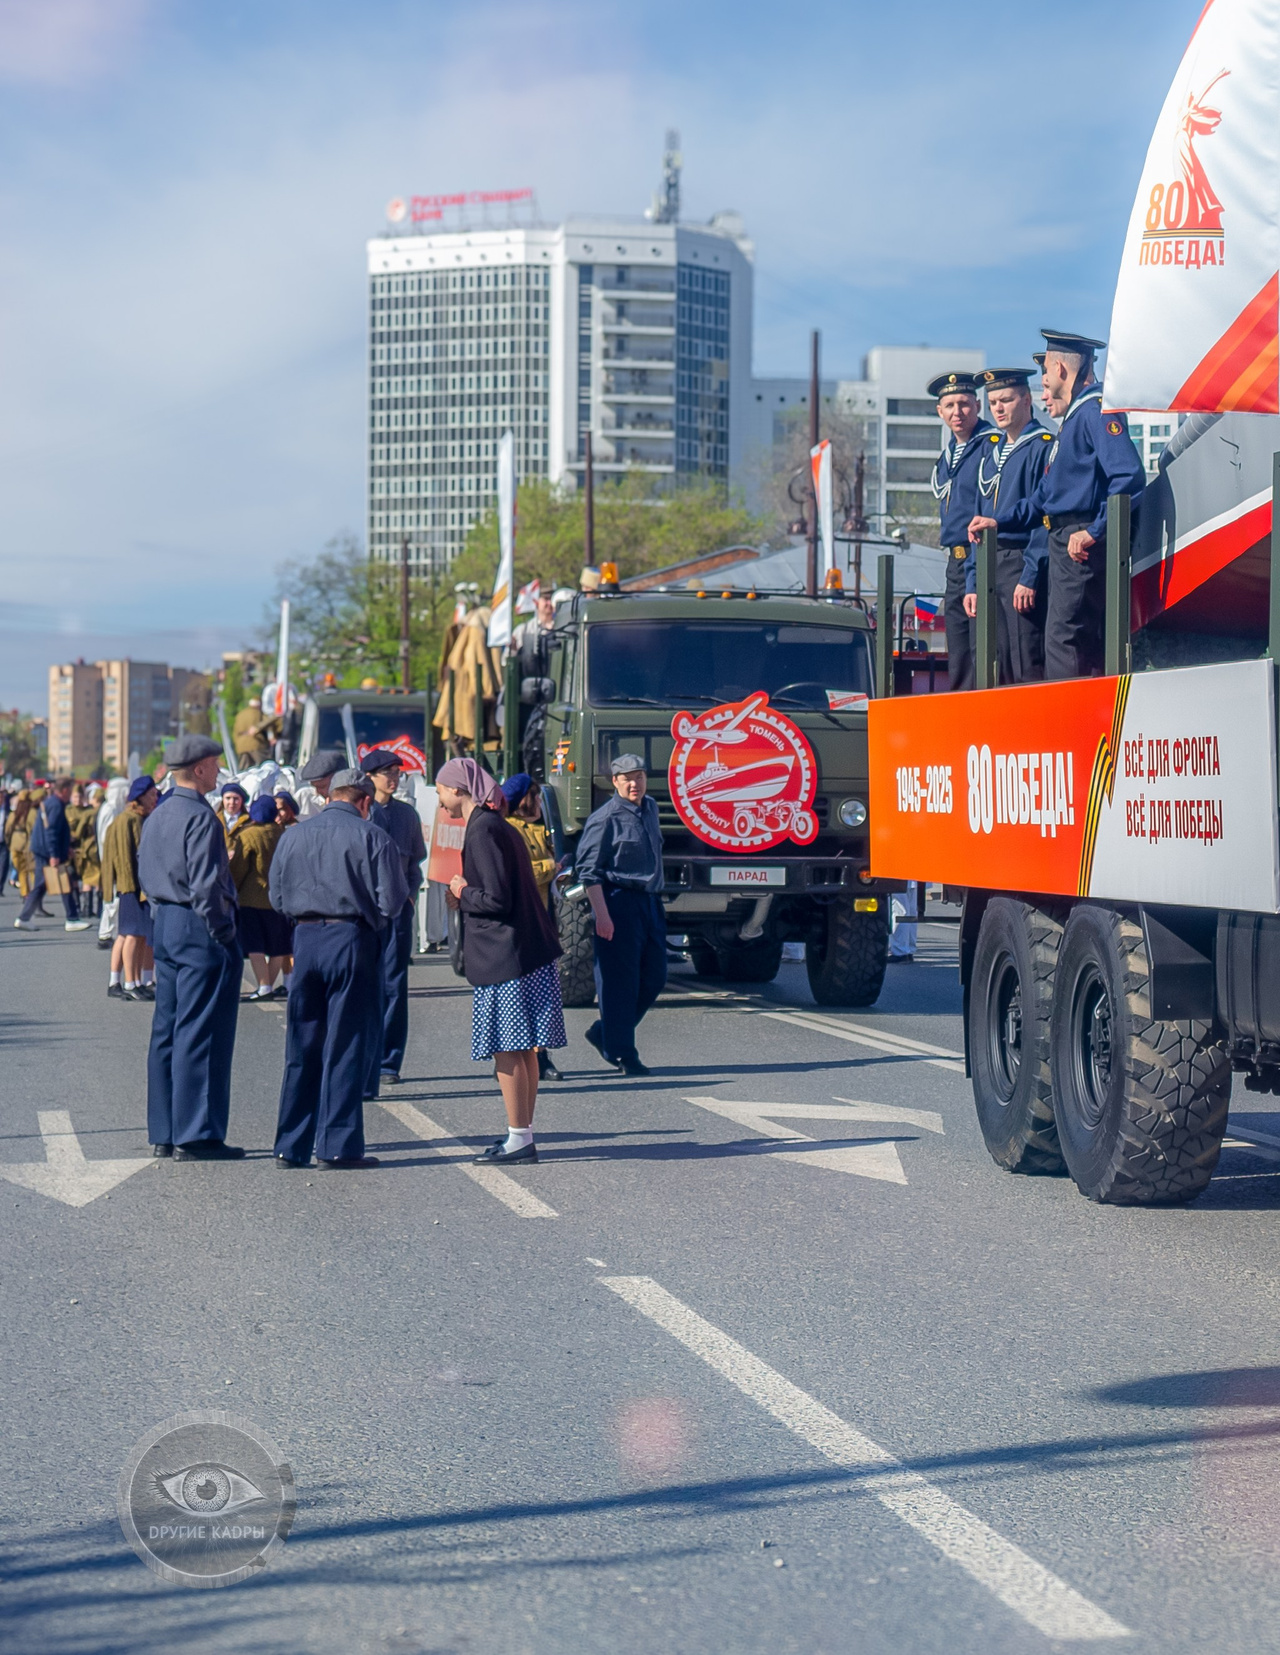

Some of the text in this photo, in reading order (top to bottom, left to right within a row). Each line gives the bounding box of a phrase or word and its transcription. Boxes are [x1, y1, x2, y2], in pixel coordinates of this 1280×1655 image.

[1145, 181, 1185, 230] 80
[1139, 240, 1225, 270] ПОБЕДА!
[749, 724, 786, 752] ТЮМЕНЬ
[1124, 733, 1221, 784] ВСЁ ДЛЯ ФРОНТА
[967, 744, 1075, 838] 80 ПОБЕДА!
[700, 803, 731, 828] ФРОНТУ
[1126, 793, 1224, 846] ВСЁ ДЛЯ ПОБЕДЫ
[728, 871, 768, 883] ПАРАД
